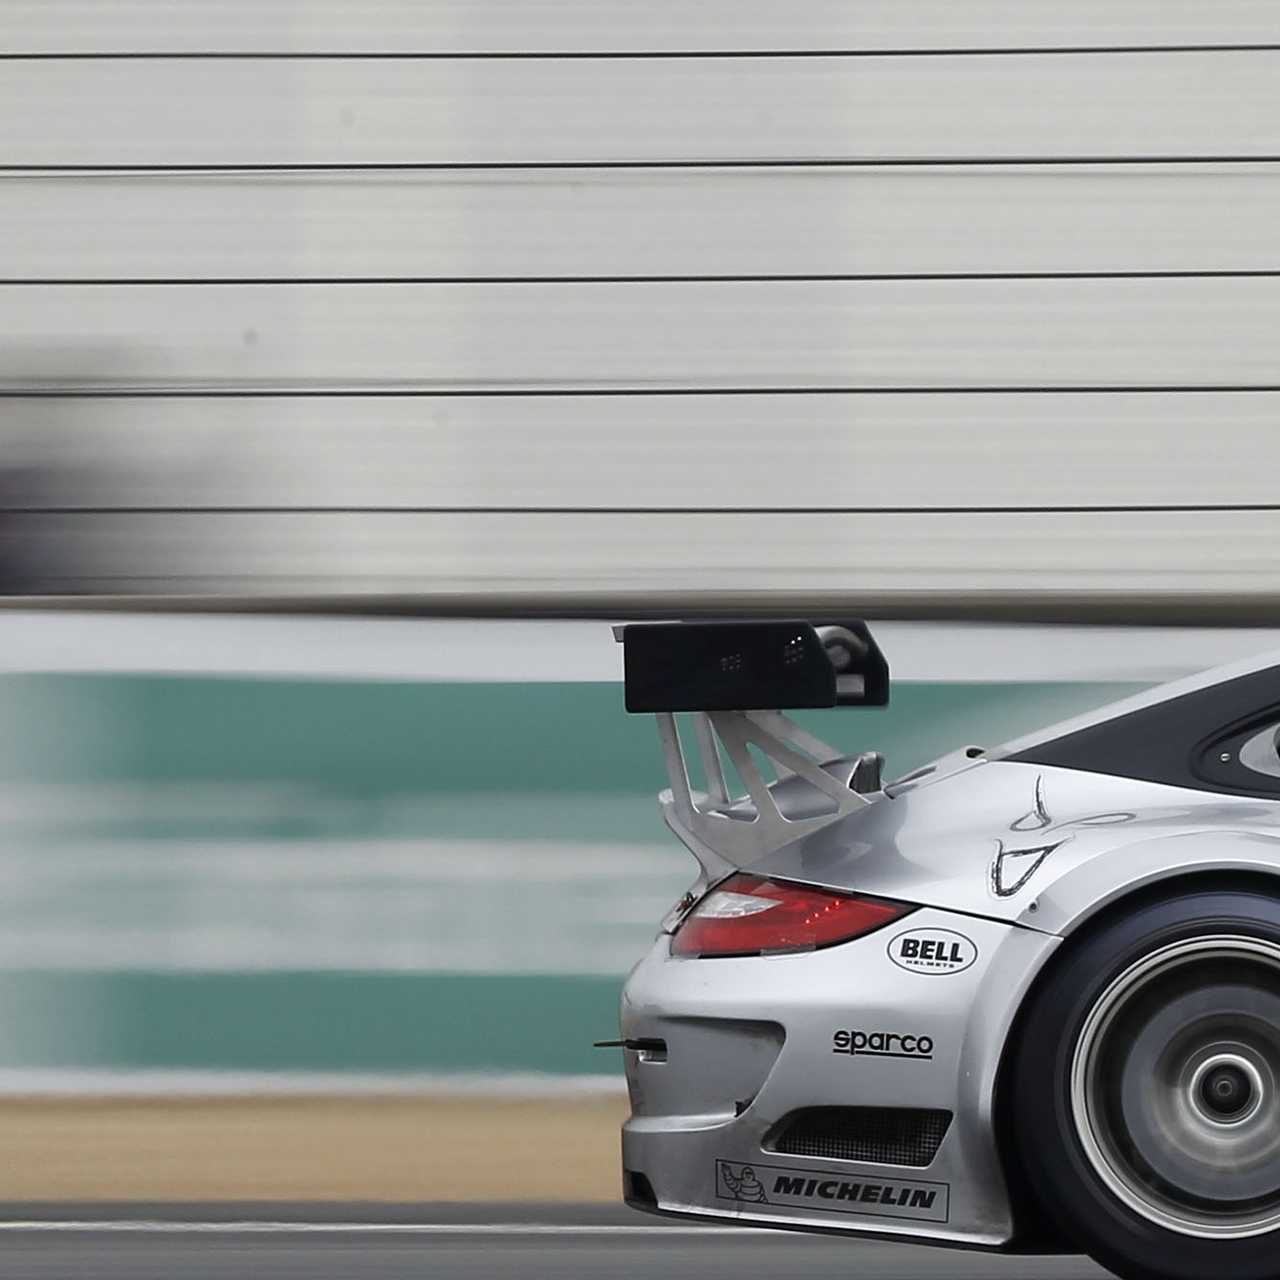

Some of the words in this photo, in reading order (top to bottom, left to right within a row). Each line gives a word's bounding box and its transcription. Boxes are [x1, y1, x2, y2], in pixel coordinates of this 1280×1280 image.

[900, 938, 964, 963] BELL
[833, 1030, 934, 1056] sparco
[772, 1174, 937, 1209] MICHELIN
